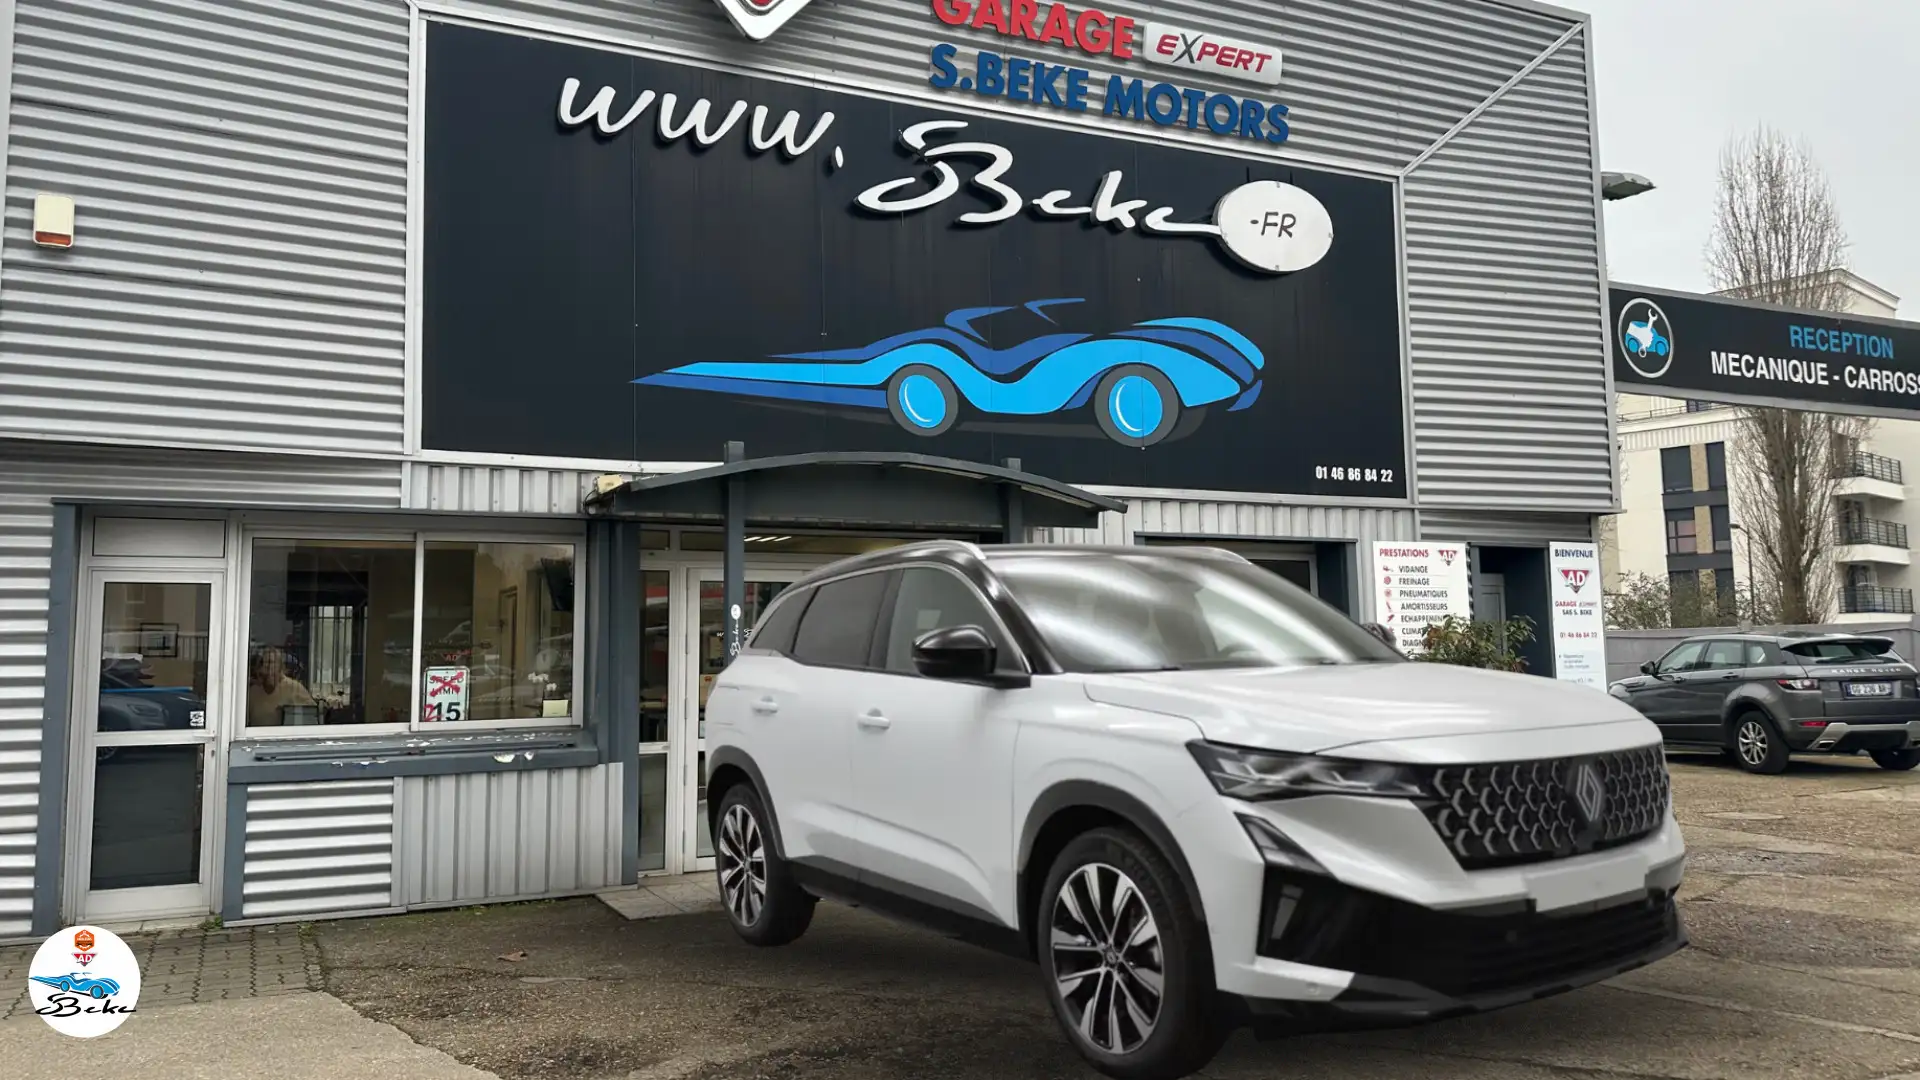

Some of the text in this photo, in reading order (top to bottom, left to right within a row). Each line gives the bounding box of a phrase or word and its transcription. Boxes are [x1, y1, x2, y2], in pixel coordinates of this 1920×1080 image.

[931, 0, 1135, 58] GARAGE
[930, 43, 1289, 144] S.BEKE MOTORS
[558, 77, 844, 168] www.
[1789, 325, 1894, 359] RECEPTION
[1711, 351, 1829, 385] MECANIQUE
[1315, 465, 1328, 479] 01
[1331, 466, 1344, 480] 46
[1364, 468, 1377, 482] 84
[1380, 469, 1393, 482] 22
[1379, 548, 1429, 558] PRESTATIONS
[1554, 549, 1593, 558] BIENVENUE
[1399, 565, 1428, 573] VIDANGE
[1399, 577, 1430, 586] FREINAGE
[1567, 571, 1585, 585] AD
[1399, 589, 1448, 598] PNEUMATIQUES
[1401, 603, 1448, 611] AMORTISSEURS
[1401, 614, 1444, 623] ECHAPPEMEN
